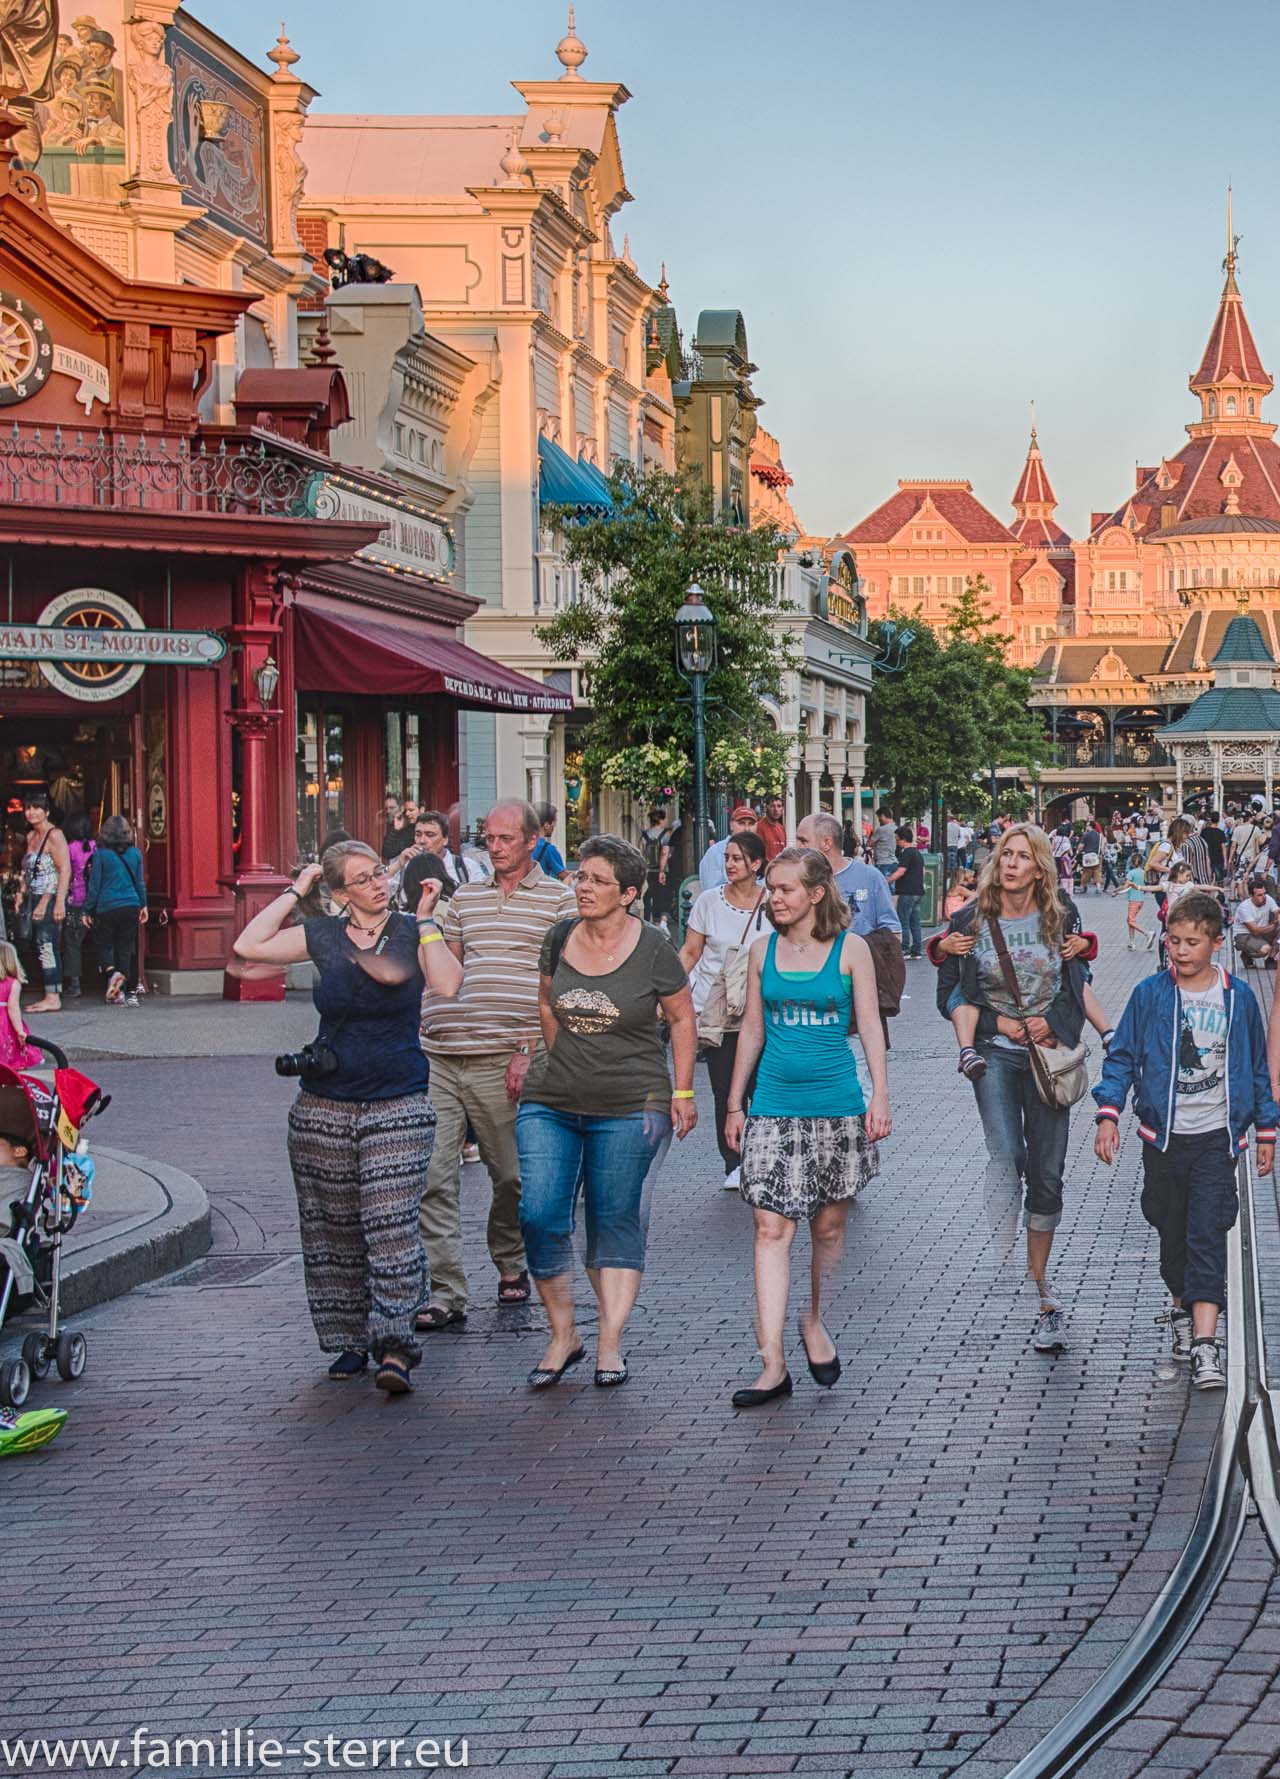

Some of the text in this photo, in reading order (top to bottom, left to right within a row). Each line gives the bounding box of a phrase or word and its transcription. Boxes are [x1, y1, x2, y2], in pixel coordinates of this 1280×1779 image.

[15, 299, 23, 312] 1
[32, 318, 44, 332] 2
[40, 343, 51, 357] 3
[34, 367, 45, 381] 4
[57, 351, 107, 386] TRADE IN
[17, 384, 28, 397] 5
[400, 521, 437, 561] MOTORS
[0, 632, 193, 655] MAIN ST. MOTORS
[444, 676, 572, 710] DEPENDABLE ALL NEW AFFORDABLE
